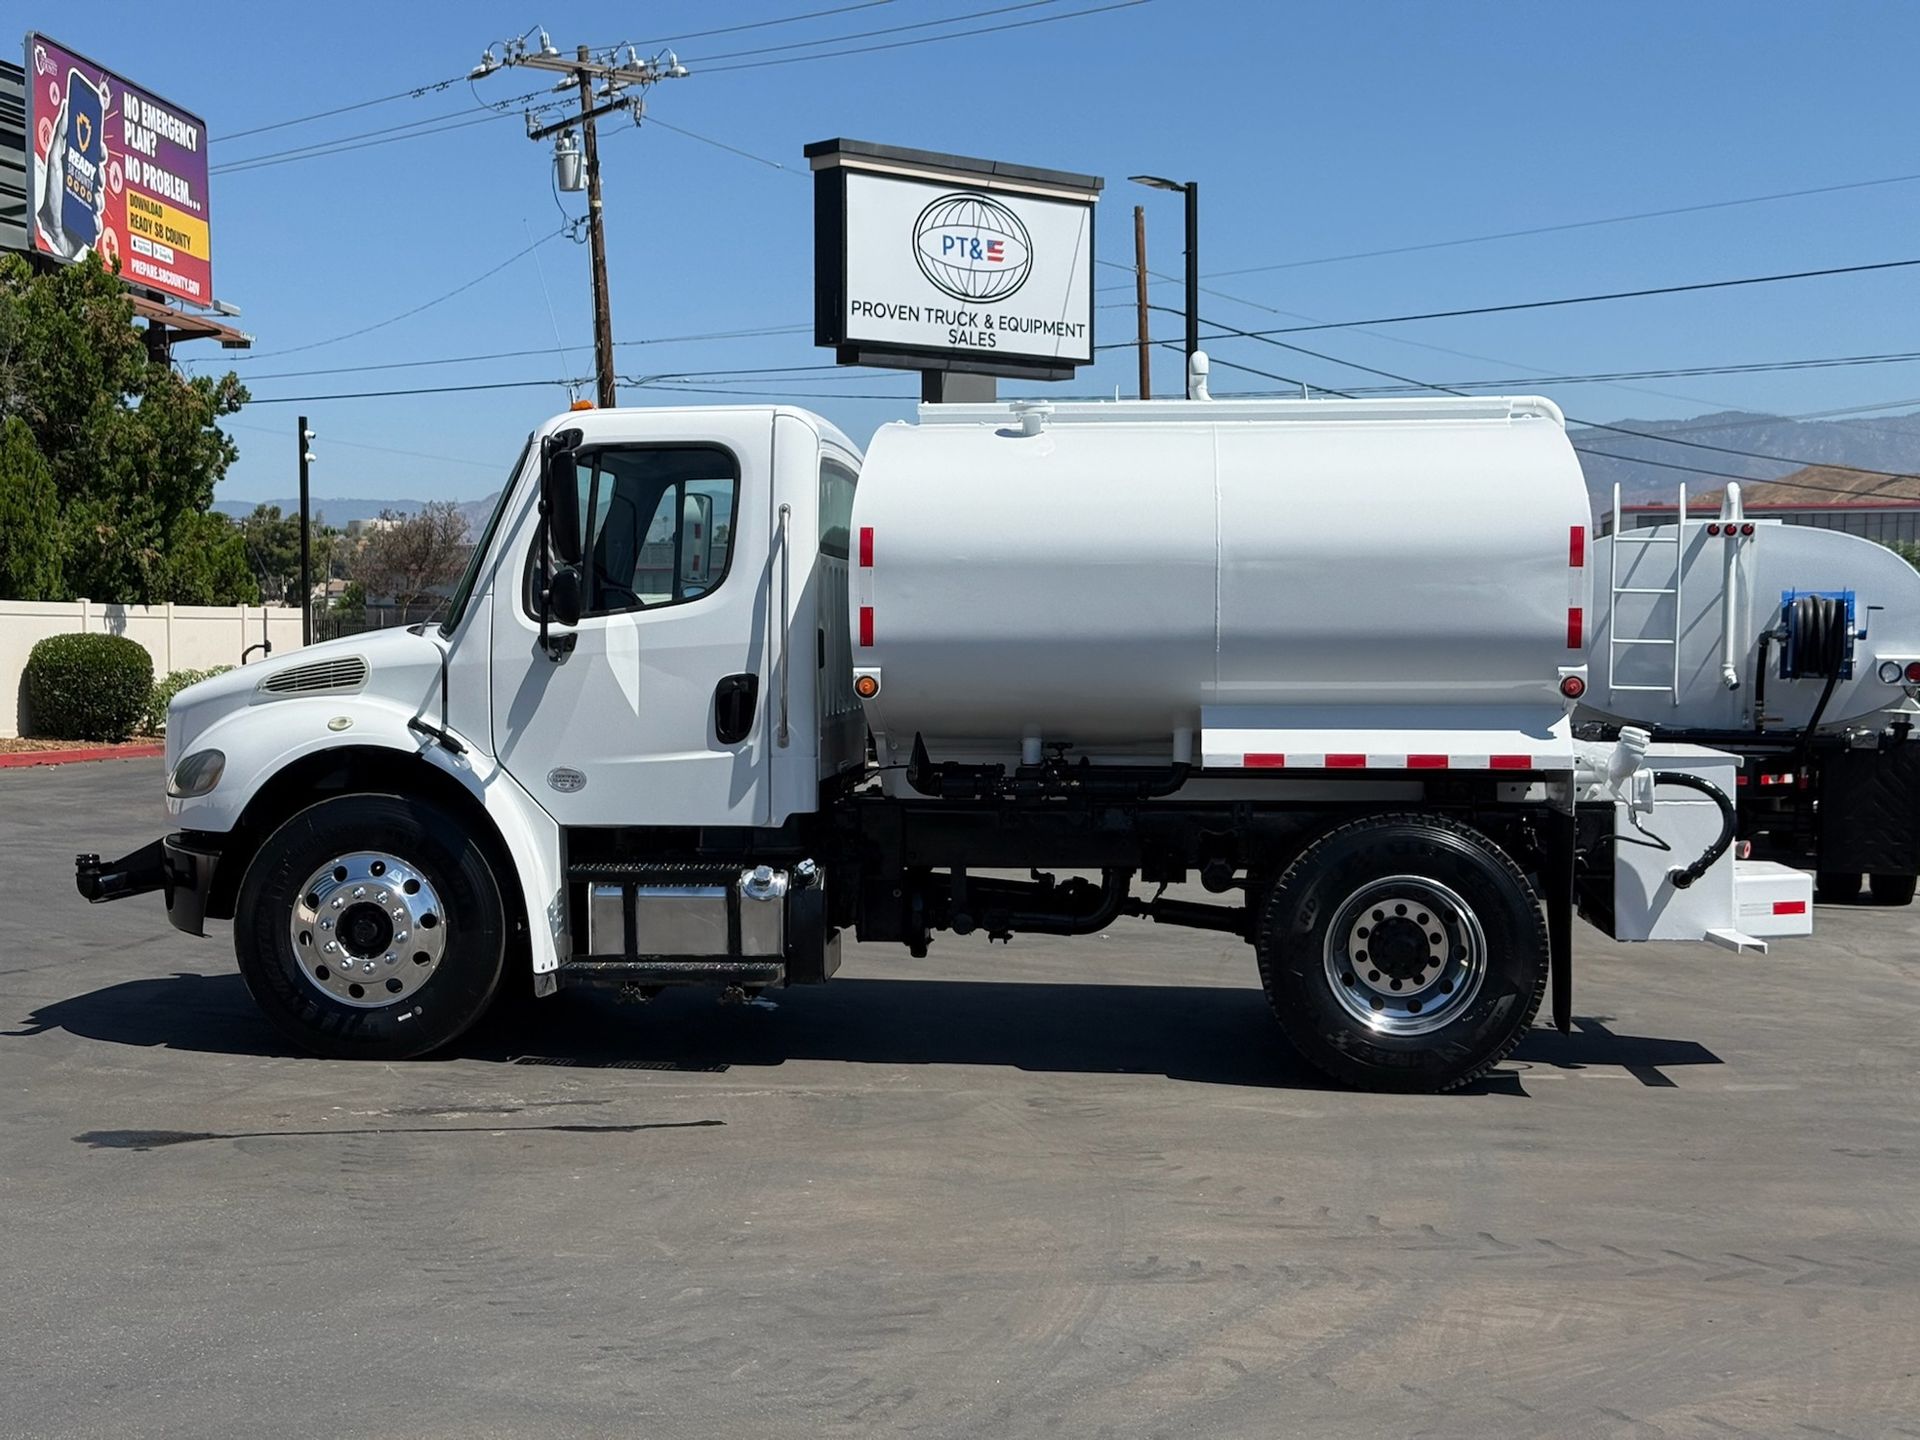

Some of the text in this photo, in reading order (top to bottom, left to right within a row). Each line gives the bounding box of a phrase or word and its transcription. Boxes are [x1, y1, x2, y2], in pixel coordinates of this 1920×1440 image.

[124, 91, 197, 152] NO EMERGENCY
[125, 120, 157, 158] PLAN?
[68, 146, 96, 181] READY
[125, 154, 200, 211] NO PROBLEM...
[130, 193, 163, 219] DOWNLOAD
[130, 213, 152, 235] READY
[155, 222, 163, 239] SB
[165, 226, 191, 250] COUNTY
[131, 258, 200, 297] PREPARE.SBCOUNTY.GOV
[851, 300, 1086, 338] PROVEN TRUCK & EQUIPMENT
[948, 329, 997, 348] SALES
